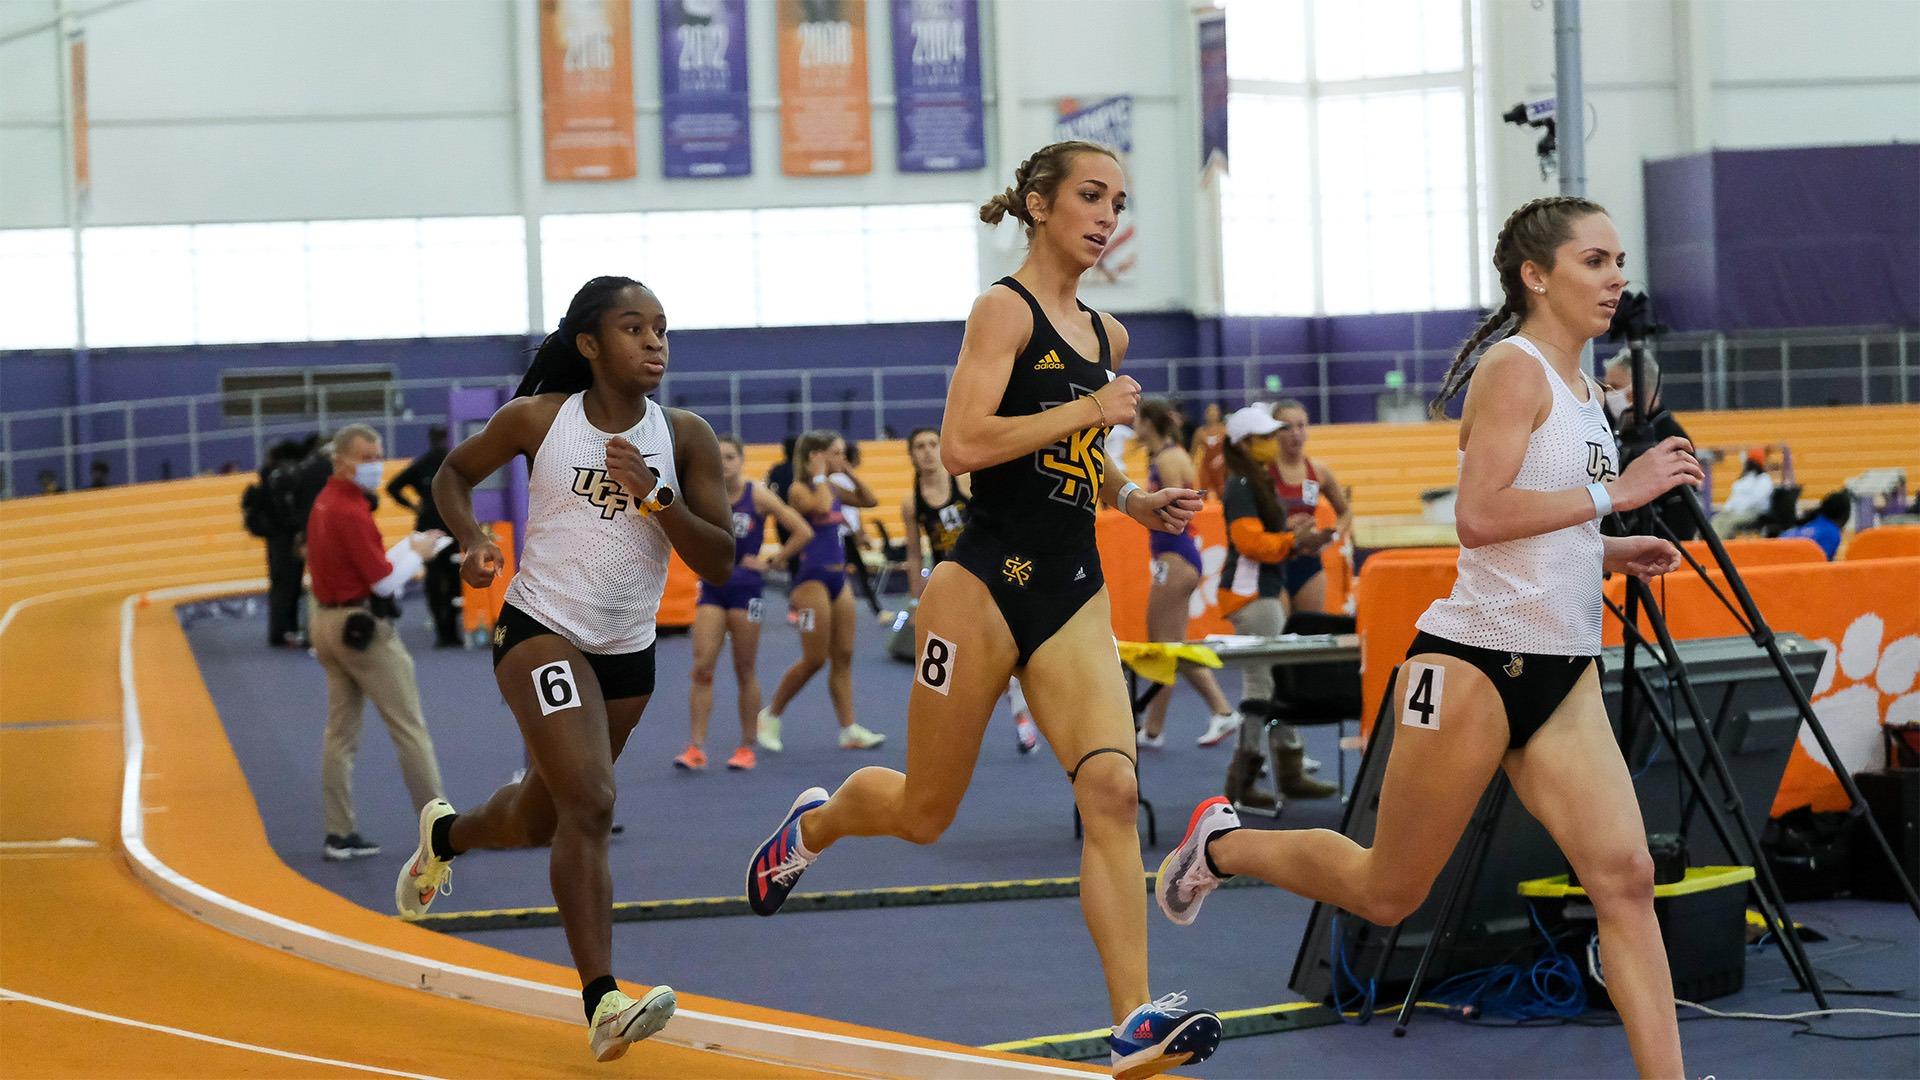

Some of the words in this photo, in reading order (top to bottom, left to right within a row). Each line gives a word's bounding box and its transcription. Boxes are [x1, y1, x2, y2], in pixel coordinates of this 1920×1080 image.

[1034, 361, 1065, 371] adidas
[572, 466, 629, 520] UCF
[540, 665, 573, 707] 6
[922, 638, 949, 687] 8
[1408, 667, 1435, 725] 4
